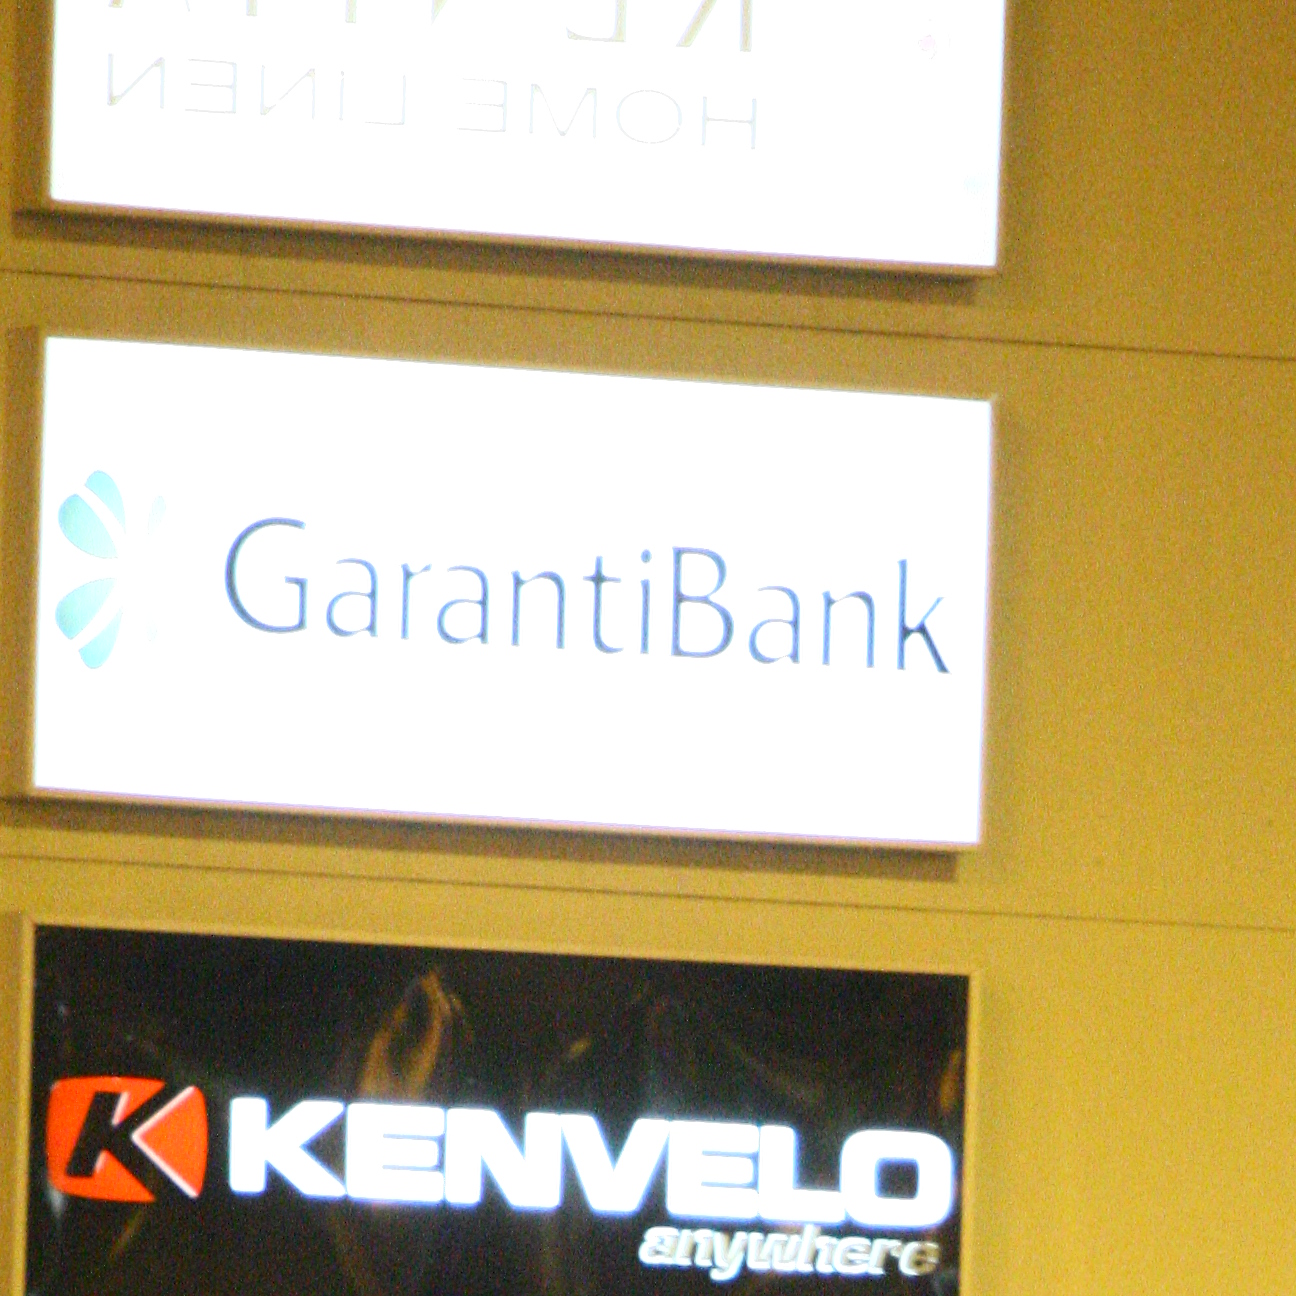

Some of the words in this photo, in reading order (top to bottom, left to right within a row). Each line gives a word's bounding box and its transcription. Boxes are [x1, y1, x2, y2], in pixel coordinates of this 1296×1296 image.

[223, 516, 952, 675] GarantiBank
[228, 1097, 955, 1229] KENVELO
[637, 1224, 942, 1282] anywhere
